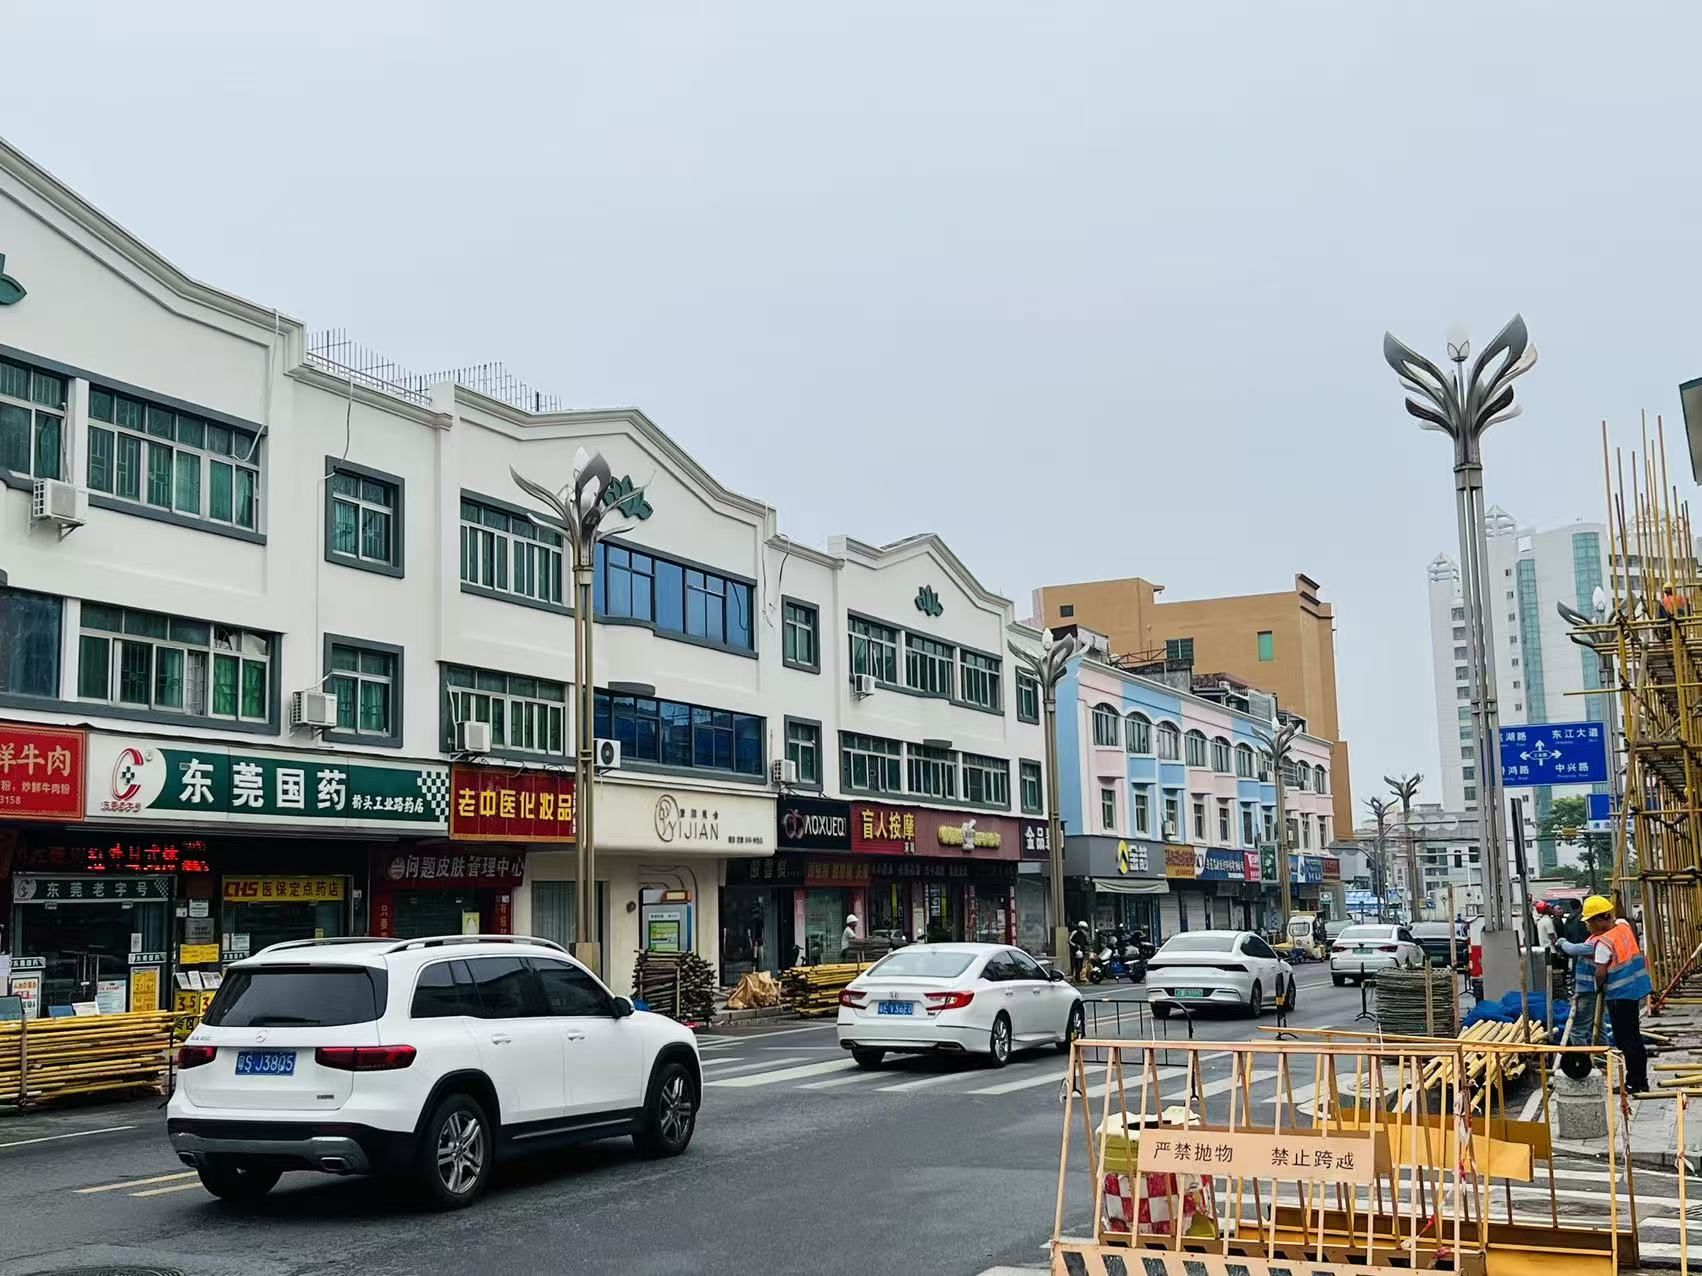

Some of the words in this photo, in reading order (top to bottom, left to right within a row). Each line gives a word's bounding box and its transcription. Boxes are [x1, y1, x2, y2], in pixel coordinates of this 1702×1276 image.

[1552, 728, 1598, 739] 东江大道
[1555, 762, 1589, 773] 中兴路
[179, 758, 347, 811] 东莞国药
[458, 787, 572, 822] 老中医化妆品
[862, 809, 915, 840] 盲人按摩
[404, 854, 525, 880] 问题皮肤管理中心
[46, 881, 149, 899] 东莞老字号
[261, 880, 340, 897] 医保定点药店
[177, 995, 196, 1012] 3.5
[1153, 1141, 1234, 1164] 严禁抛物
[1271, 1147, 1355, 1171] 禁止跨越
